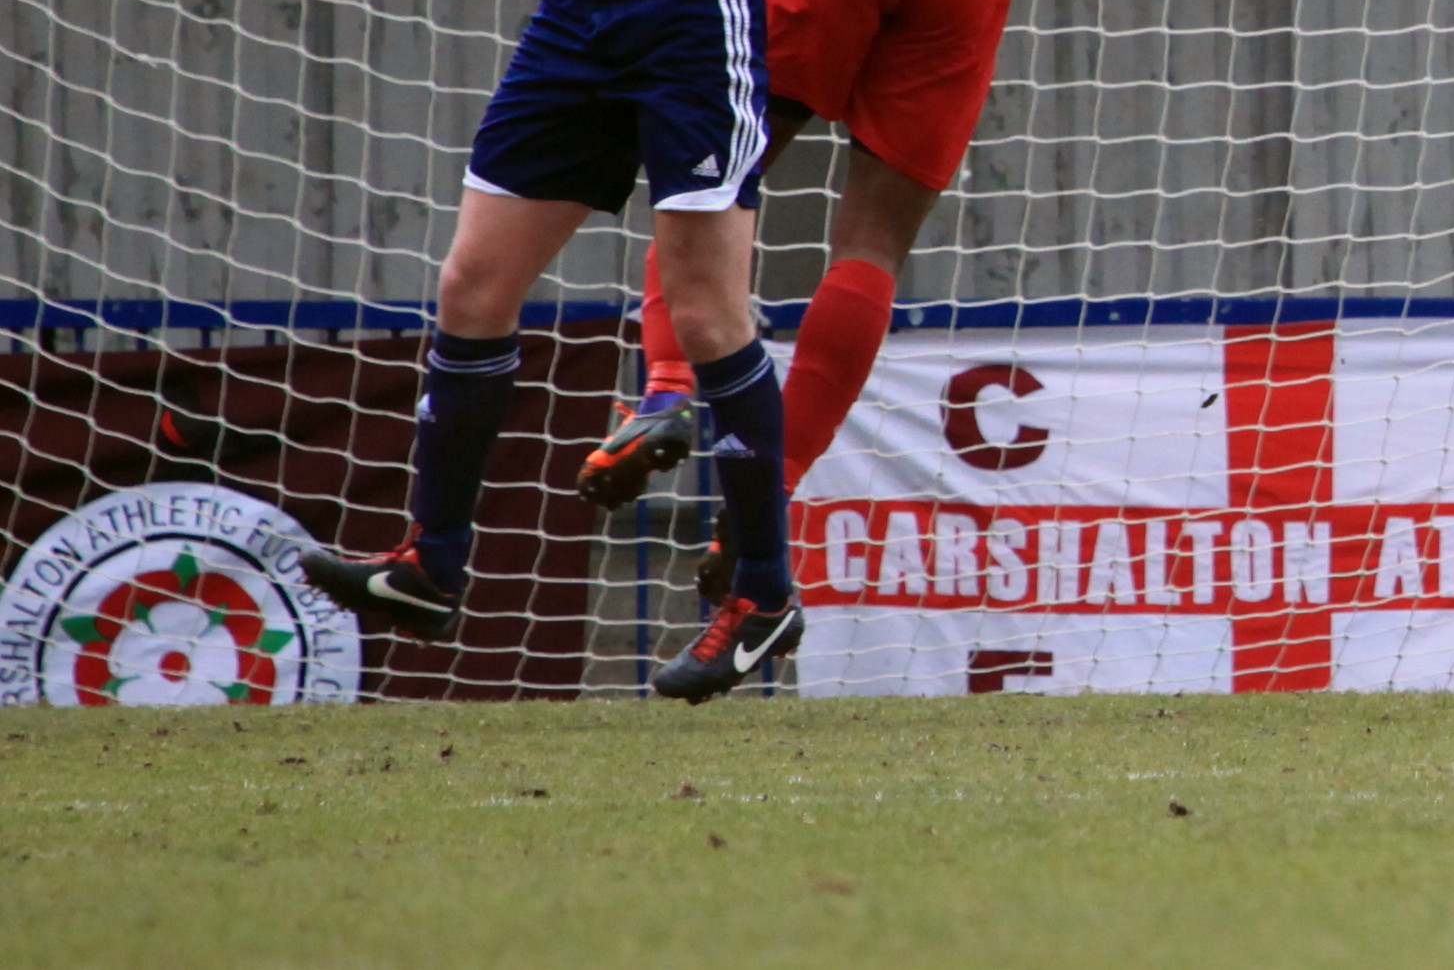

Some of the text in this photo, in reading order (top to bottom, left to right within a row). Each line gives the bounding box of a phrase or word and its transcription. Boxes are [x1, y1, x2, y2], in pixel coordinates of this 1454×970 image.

[940, 364, 1050, 471] C
[86, 495, 241, 551] ATHLETIC
[246, 517, 346, 667] FOOBALL
[824, 509, 1332, 606] CARSHALTON
